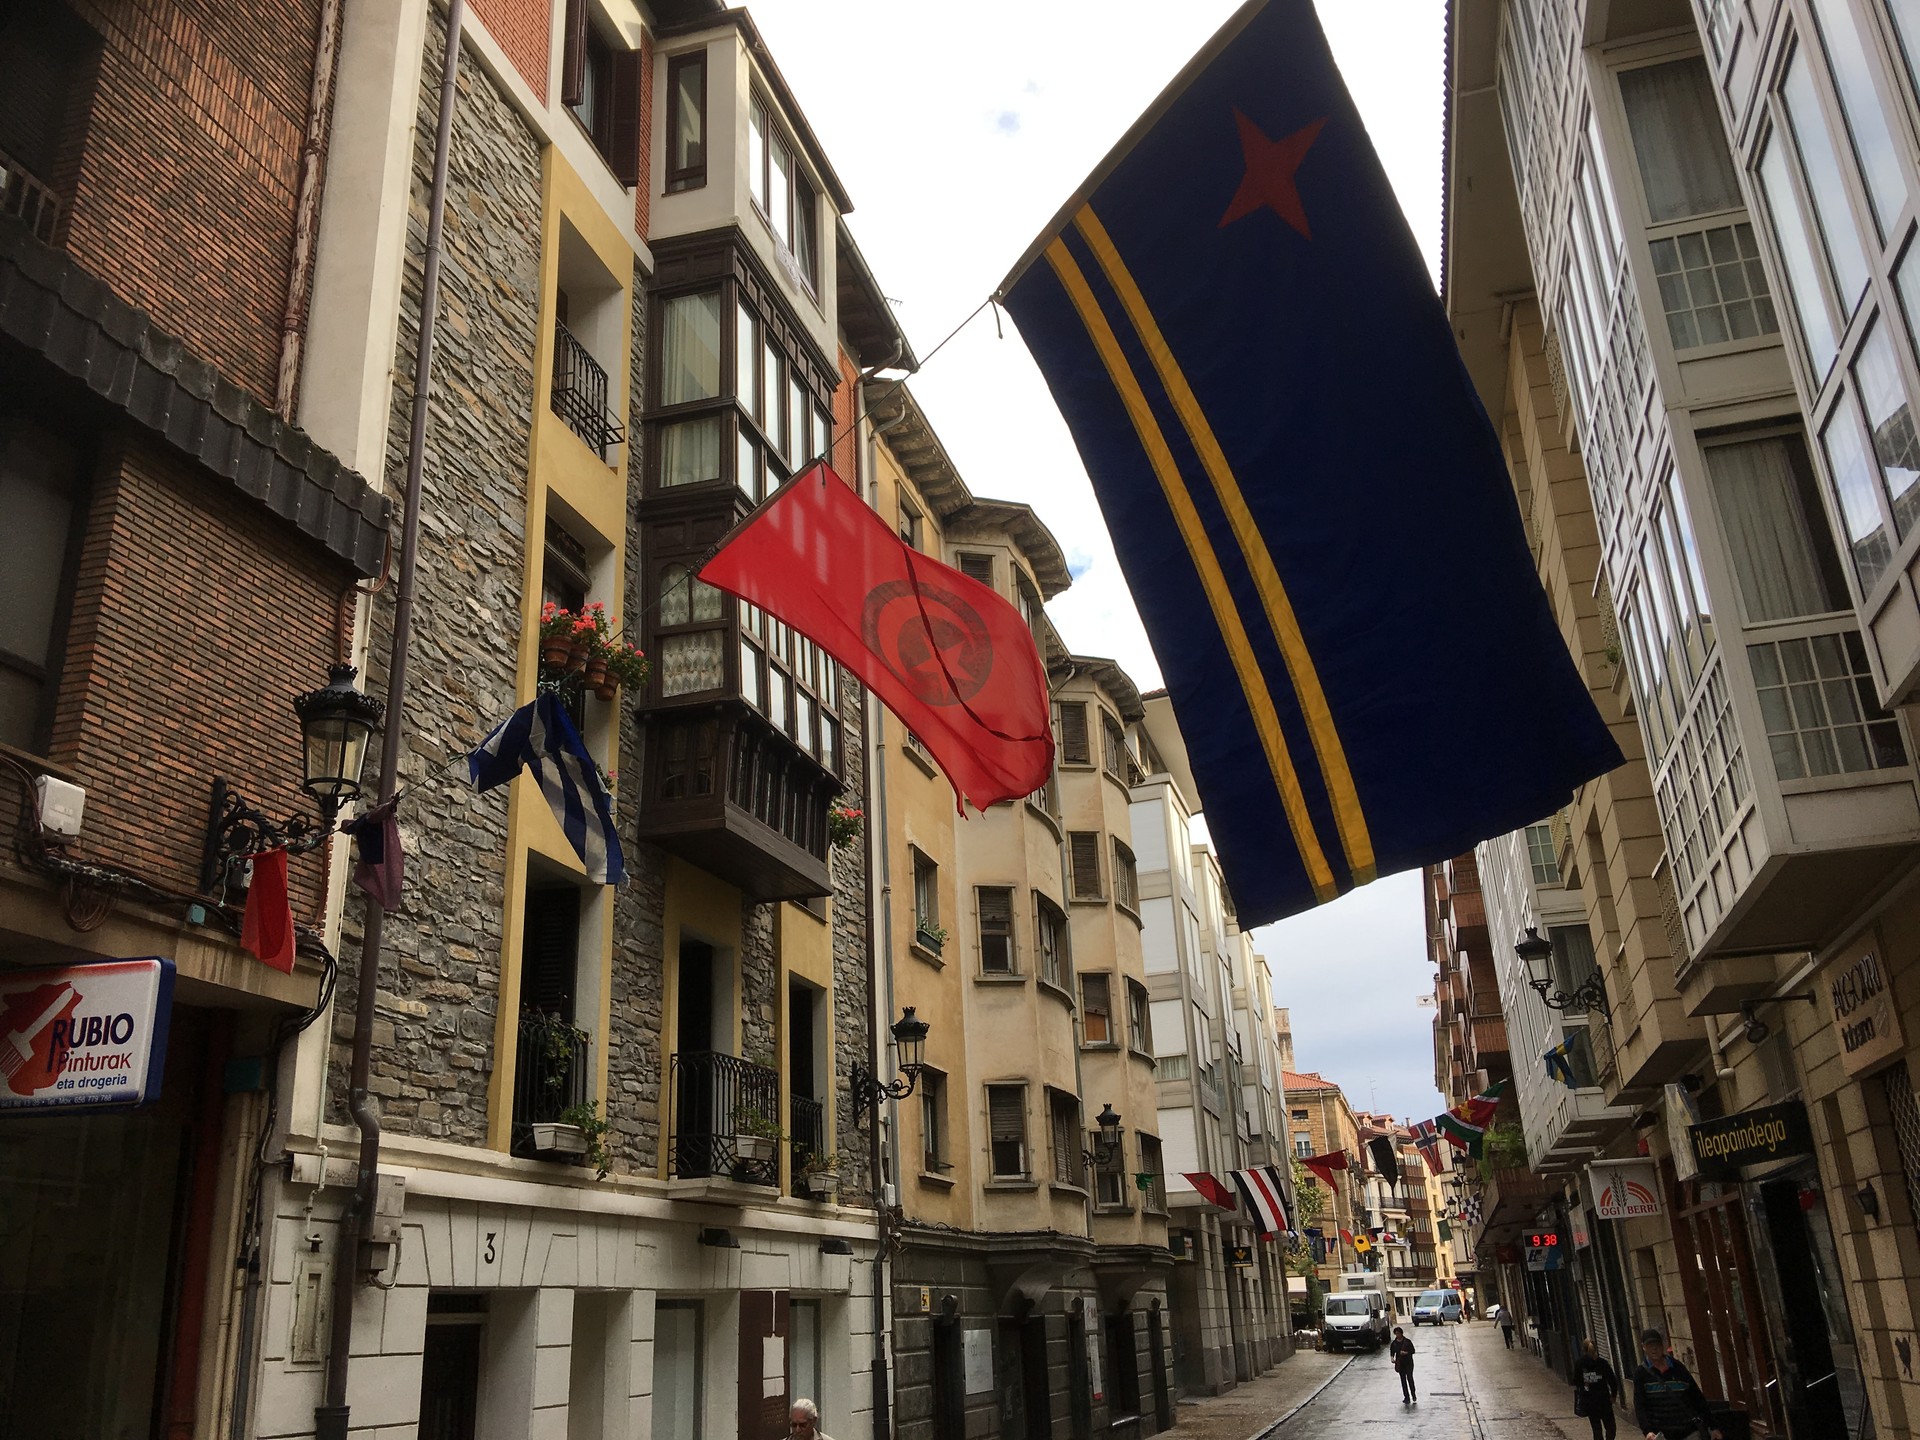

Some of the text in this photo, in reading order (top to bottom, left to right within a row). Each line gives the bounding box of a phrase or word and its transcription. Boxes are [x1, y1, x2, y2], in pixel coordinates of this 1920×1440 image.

[47, 1012, 134, 1073] RUBIO
[57, 1074, 127, 1090] eta drogeria
[1695, 1113, 1786, 1162] ileapaindegia
[1601, 1204, 1658, 1216] OGI BERRI
[484, 1232, 497, 1265] 3
